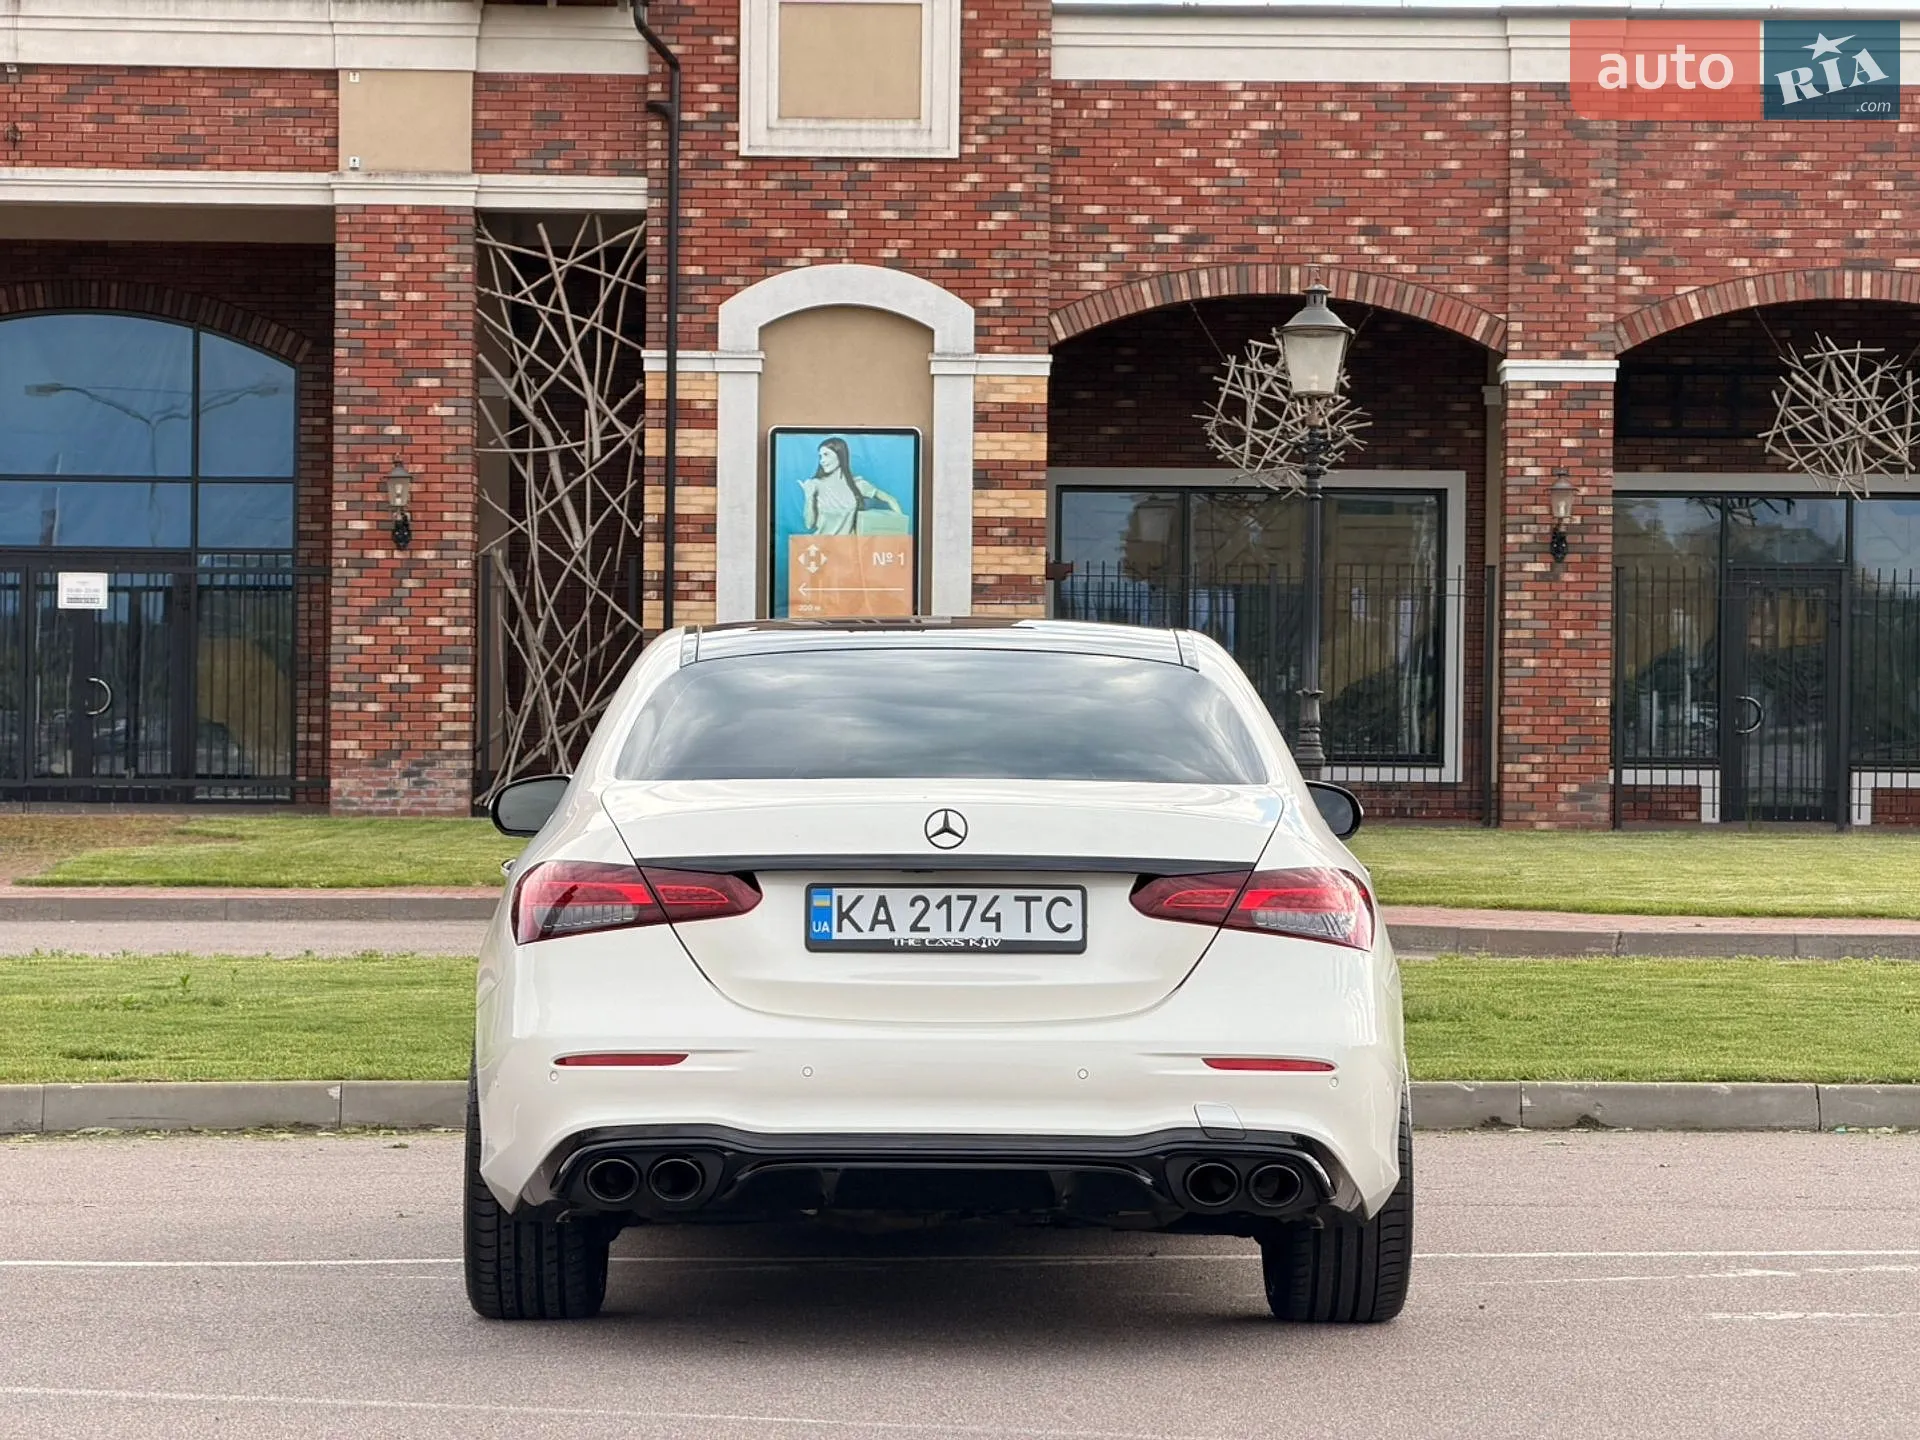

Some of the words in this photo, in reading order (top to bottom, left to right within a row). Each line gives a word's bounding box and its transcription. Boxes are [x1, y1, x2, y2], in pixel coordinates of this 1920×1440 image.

[836, 894, 896, 933] KA
[909, 894, 1001, 933] 2174
[1014, 895, 1073, 933] TC
[812, 922, 830, 932] UA
[893, 937, 921, 947] THE
[925, 937, 965, 947] CARS
